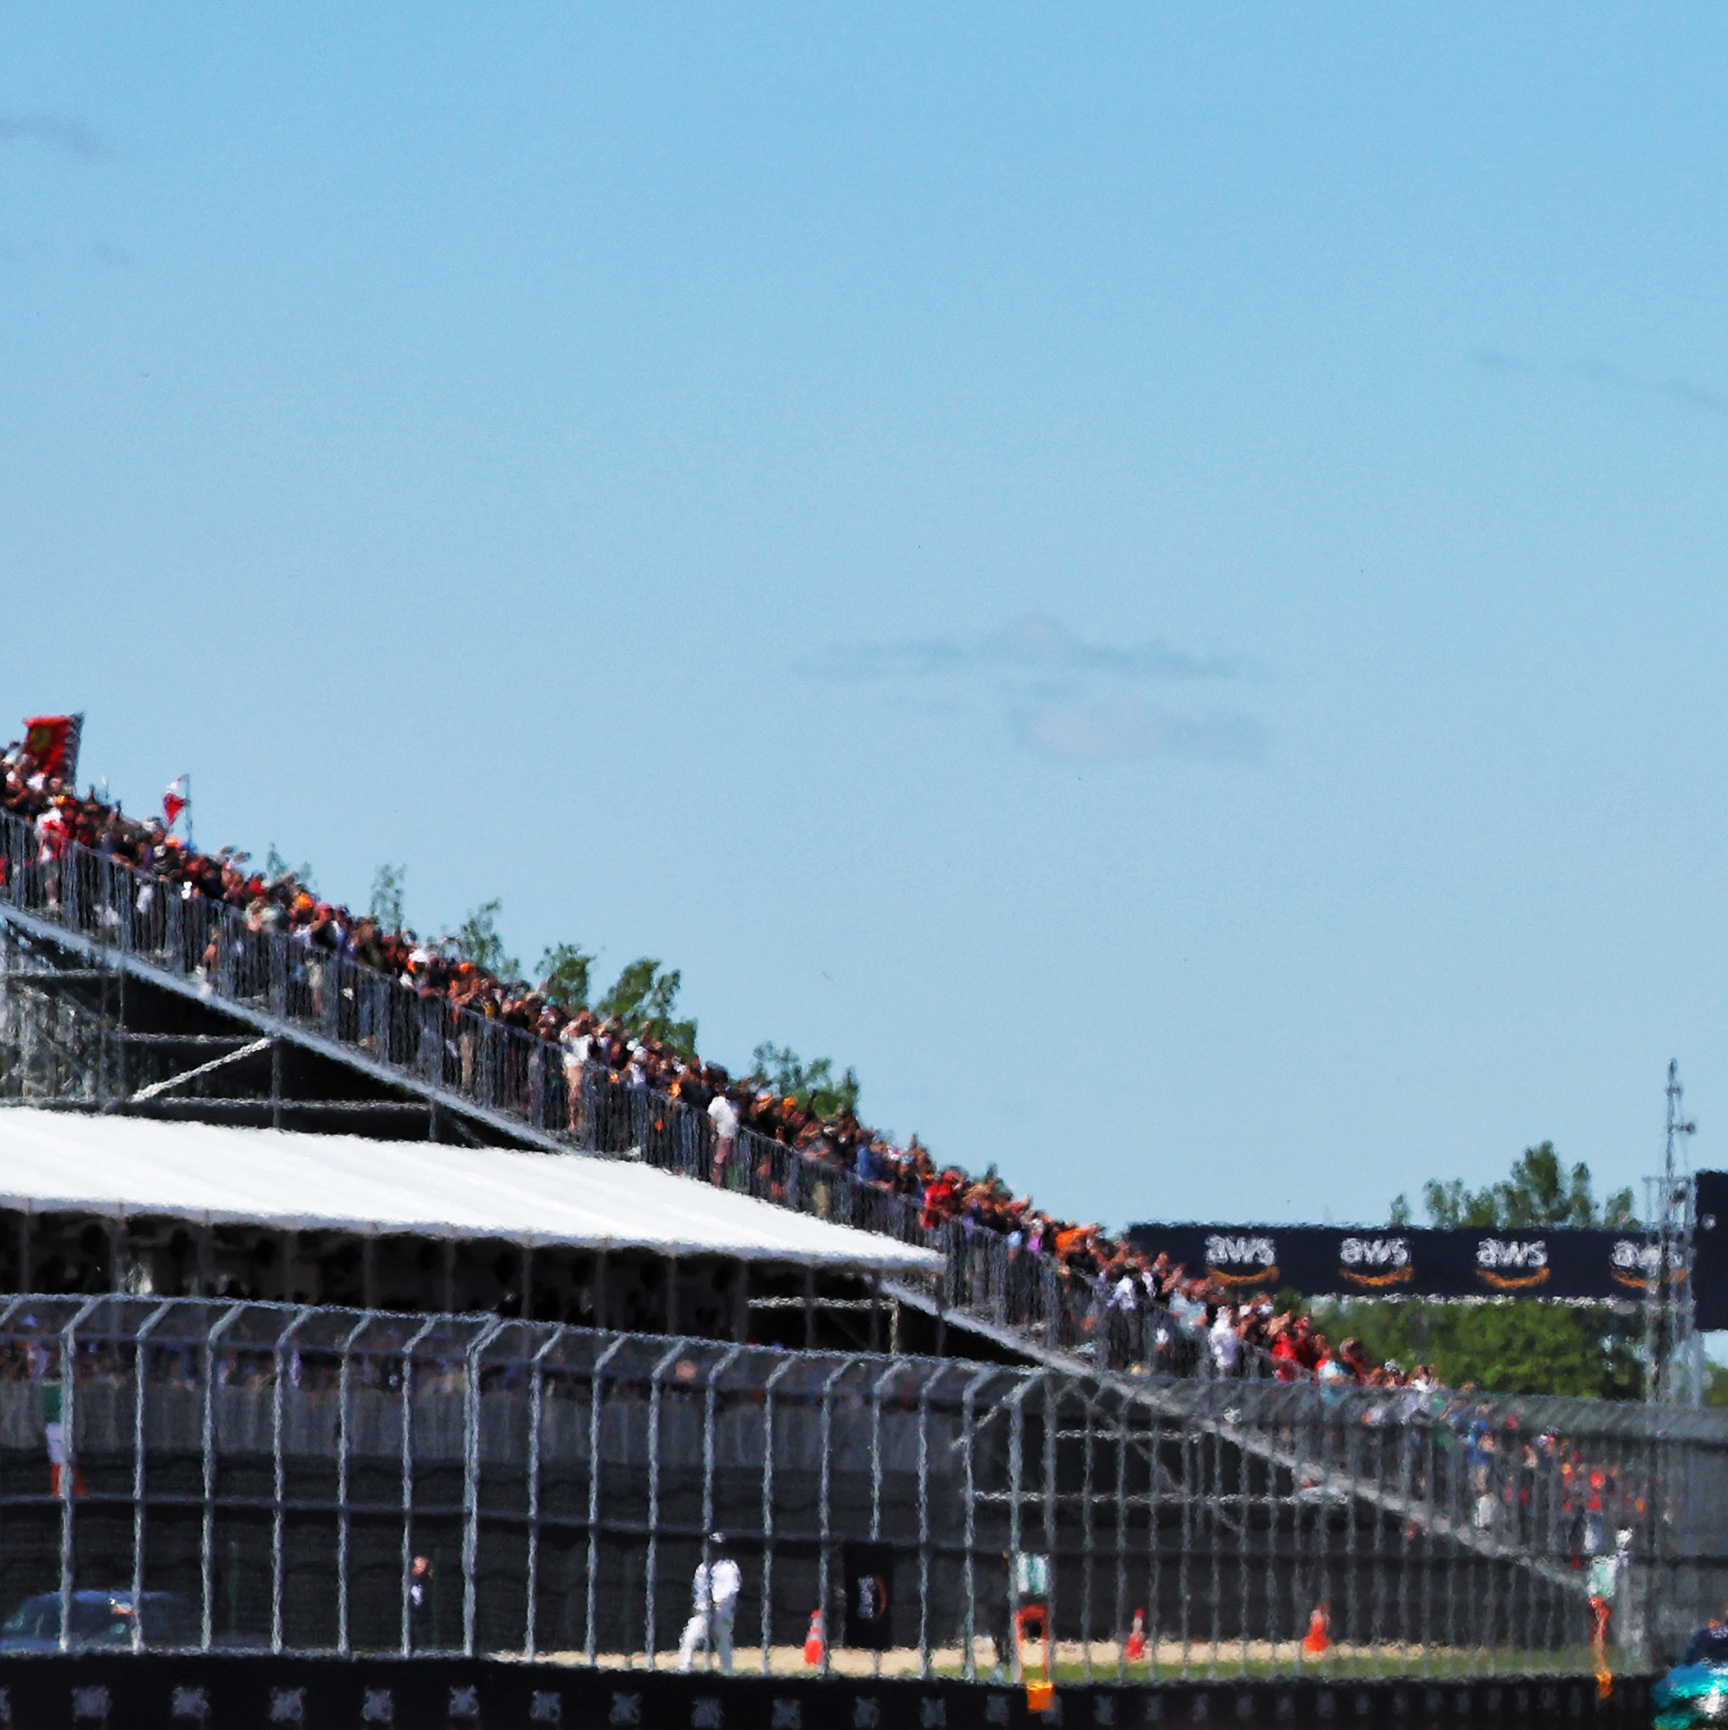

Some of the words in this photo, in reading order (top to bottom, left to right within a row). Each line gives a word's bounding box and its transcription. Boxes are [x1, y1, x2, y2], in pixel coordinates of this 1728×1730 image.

[1204, 1235, 1276, 1267] aws
[1339, 1236, 1410, 1268] aws
[1475, 1237, 1547, 1269] aws
